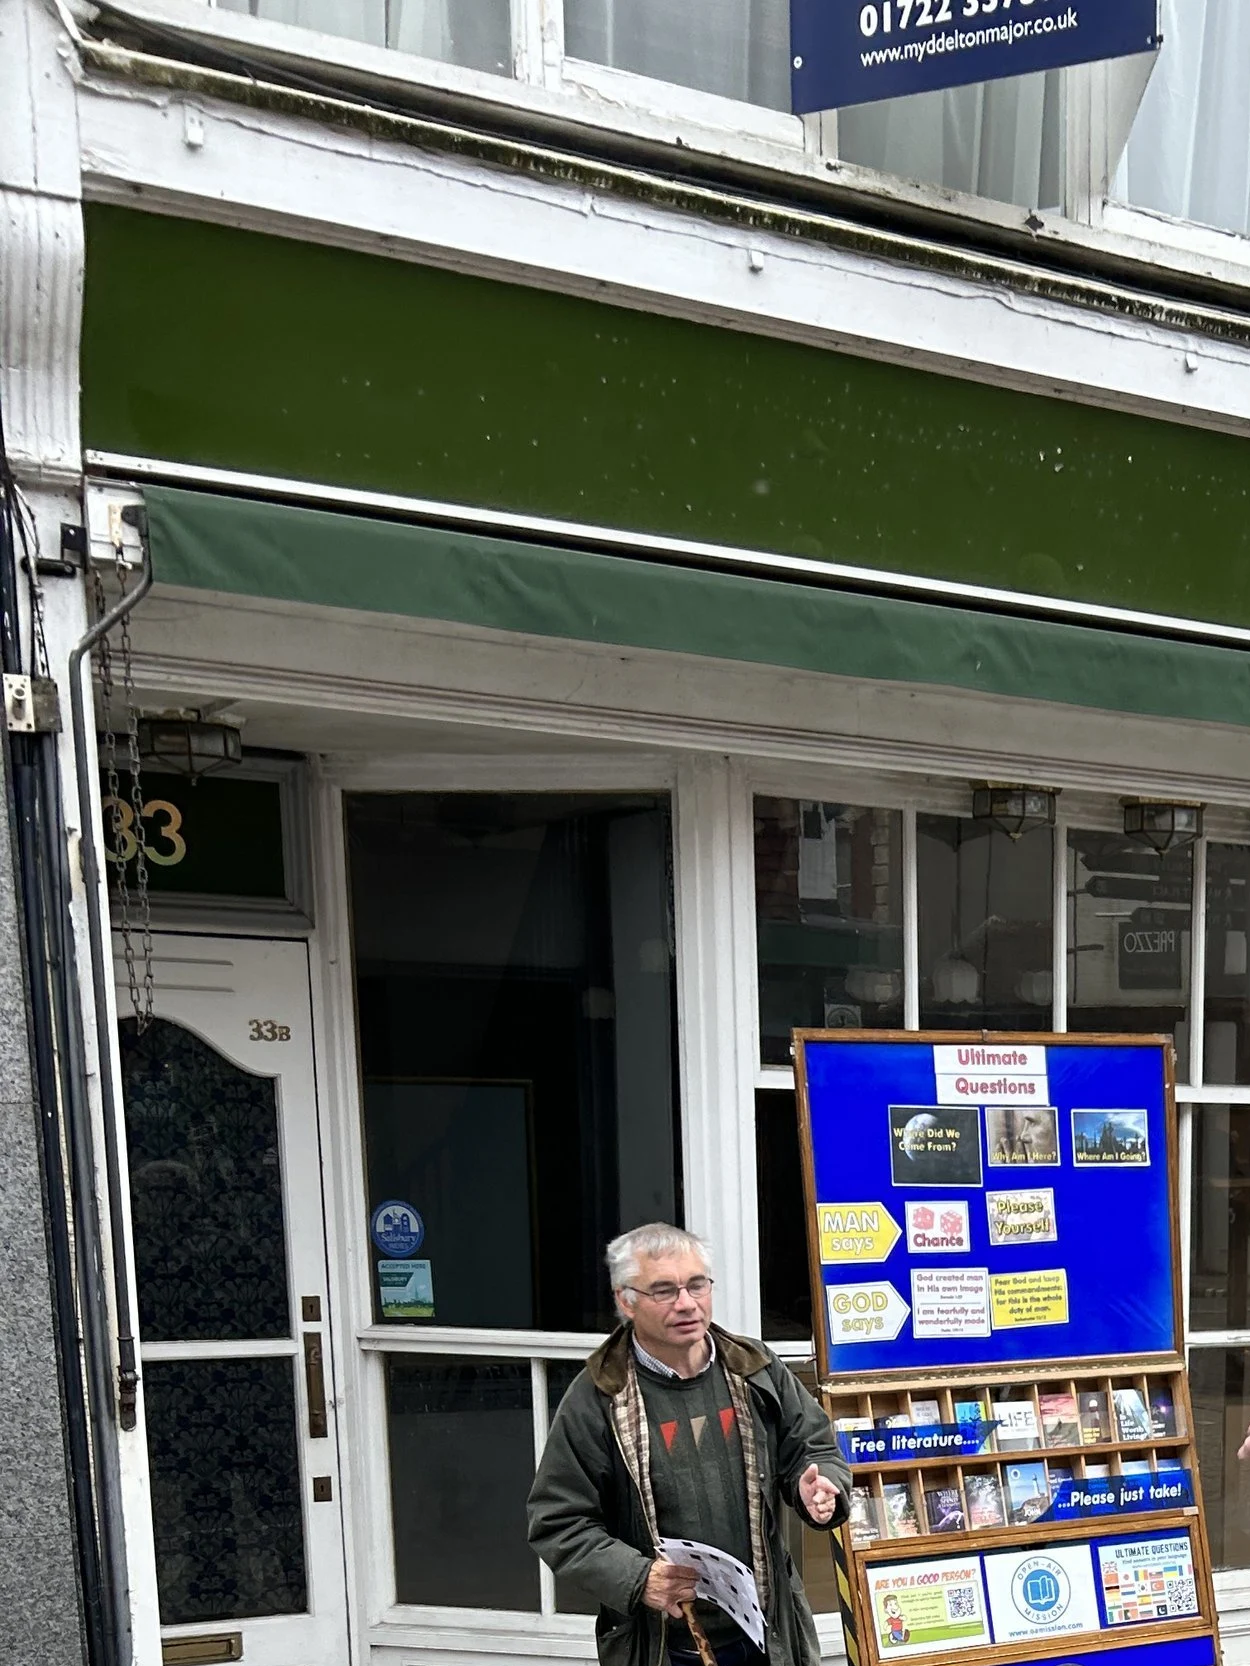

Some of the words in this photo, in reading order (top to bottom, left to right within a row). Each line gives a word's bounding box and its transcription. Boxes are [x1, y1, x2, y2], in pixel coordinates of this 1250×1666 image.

[860, 0, 953, 37] 01722
[860, 7, 1078, 67] www.myddeltonmajor.co.uk
[957, 1048, 1028, 1066] Ultimate
[955, 1077, 1036, 1095] Questions
[927, 1128, 944, 1139] Did
[945, 1128, 960, 1139] We
[927, 1142, 956, 1151] From?
[992, 1152, 1009, 1162] Why
[1012, 1152, 1024, 1160] Am
[1032, 1151, 1056, 1160] Here?
[1077, 1152, 1100, 1160] Where
[1102, 1152, 1114, 1160] Am
[1120, 1151, 1146, 1162] Going?
[996, 1200, 1043, 1214] Please
[823, 1211, 880, 1233] MAN
[994, 1219, 1050, 1235] Yourself
[832, 1236, 874, 1255] says
[912, 1233, 964, 1248] Chance
[832, 1291, 889, 1315] GOD
[1008, 1297, 1020, 1305] this
[1042, 1294, 1062, 1302] whole
[937, 1307, 968, 1317] fearfully
[842, 1316, 884, 1336] says
[918, 1318, 962, 1326] wonderfully
[998, 1411, 1035, 1427] LIFE
[1122, 1425, 1144, 1433] Worth
[850, 1436, 885, 1453] Free
[1058, 1491, 1115, 1508] ...Please
[1120, 1487, 1144, 1506] just
[1150, 1482, 1181, 1499] take!
[1115, 1546, 1150, 1558] ULTIMATE
[1151, 1542, 1188, 1555] QUESTIONS
[1017, 1560, 1062, 1580] OPEN-AIR
[875, 1579, 890, 1590] ARE
[892, 1577, 907, 1588] YOU
[910, 1577, 916, 1585] A
[917, 1573, 939, 1585] GOOD
[941, 1568, 976, 1581] PERSON?
[1024, 1603, 1063, 1621] MISSION
[1008, 1622, 1083, 1637] www.oamission.com
